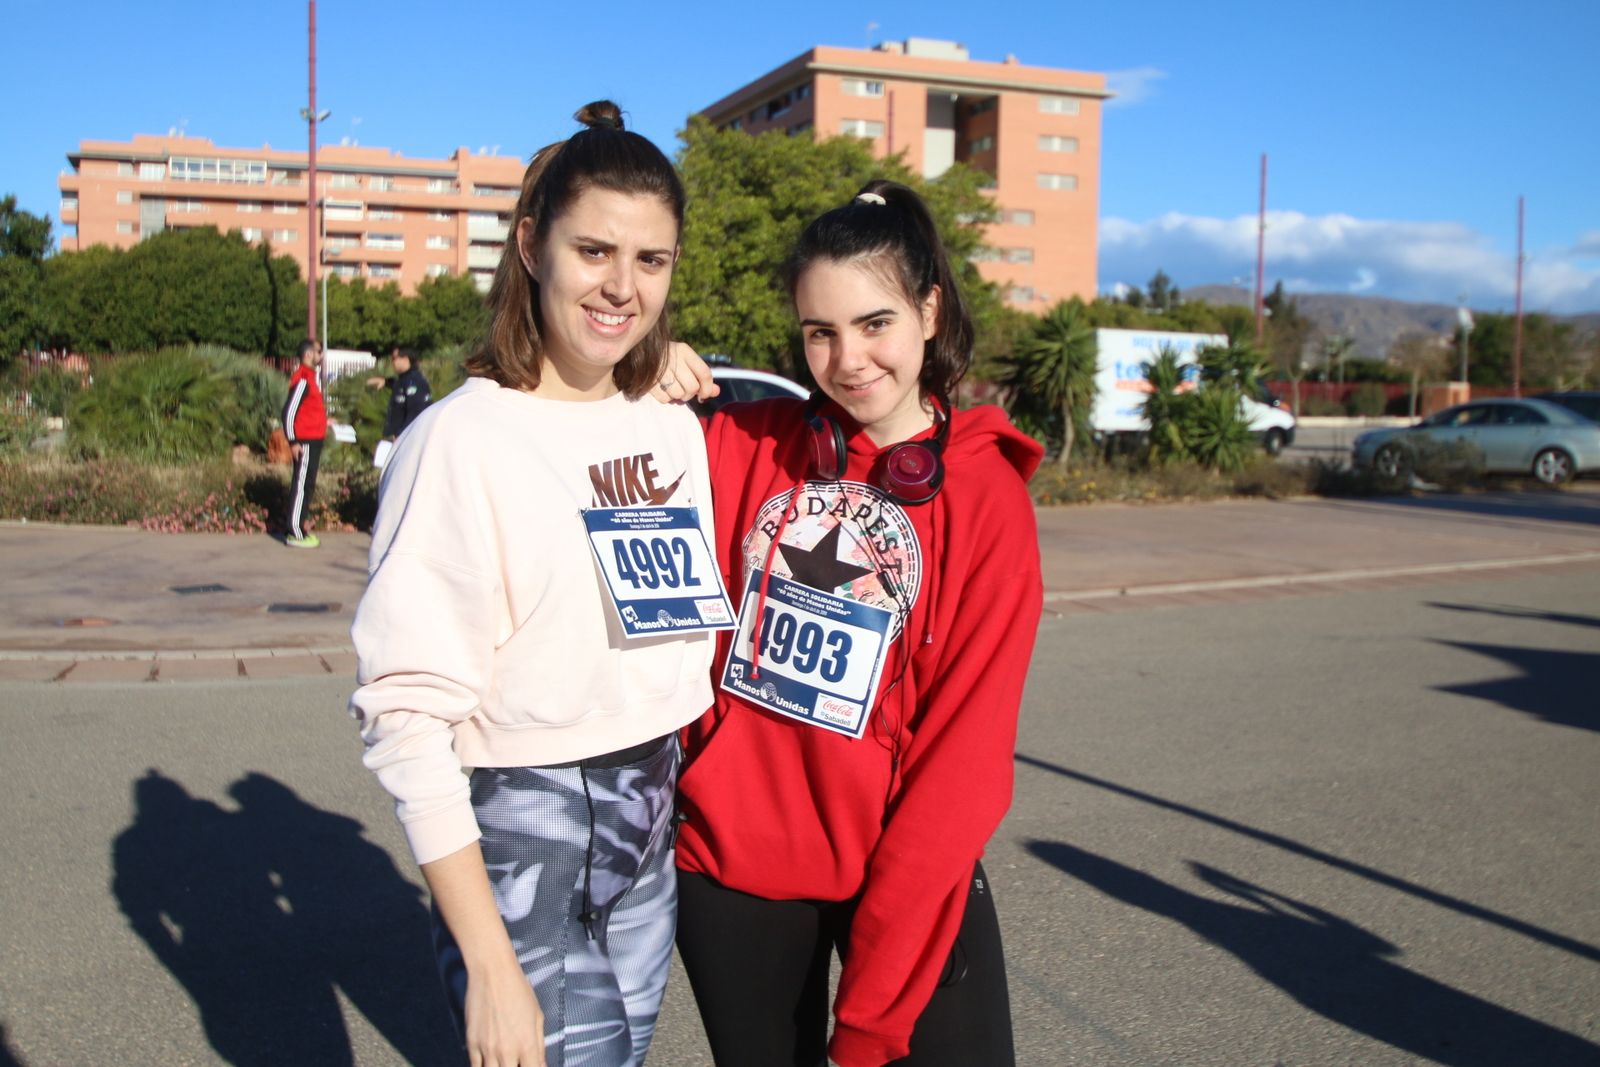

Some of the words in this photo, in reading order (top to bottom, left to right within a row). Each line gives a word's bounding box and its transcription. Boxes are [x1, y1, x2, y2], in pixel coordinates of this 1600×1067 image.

[588, 452, 665, 507] NIKE
[612, 537, 701, 589] 4992
[784, 584, 810, 599] CARRERA
[810, 593, 844, 608] SOLIDARIA
[787, 591, 799, 600] años
[806, 598, 826, 610] Manos
[633, 620, 660, 630] Manos
[673, 617, 701, 627] Unidas
[749, 606, 852, 682] 4993
[733, 678, 761, 696] Manos
[775, 696, 809, 715] Unidas
[824, 713, 851, 726] Sabadell
